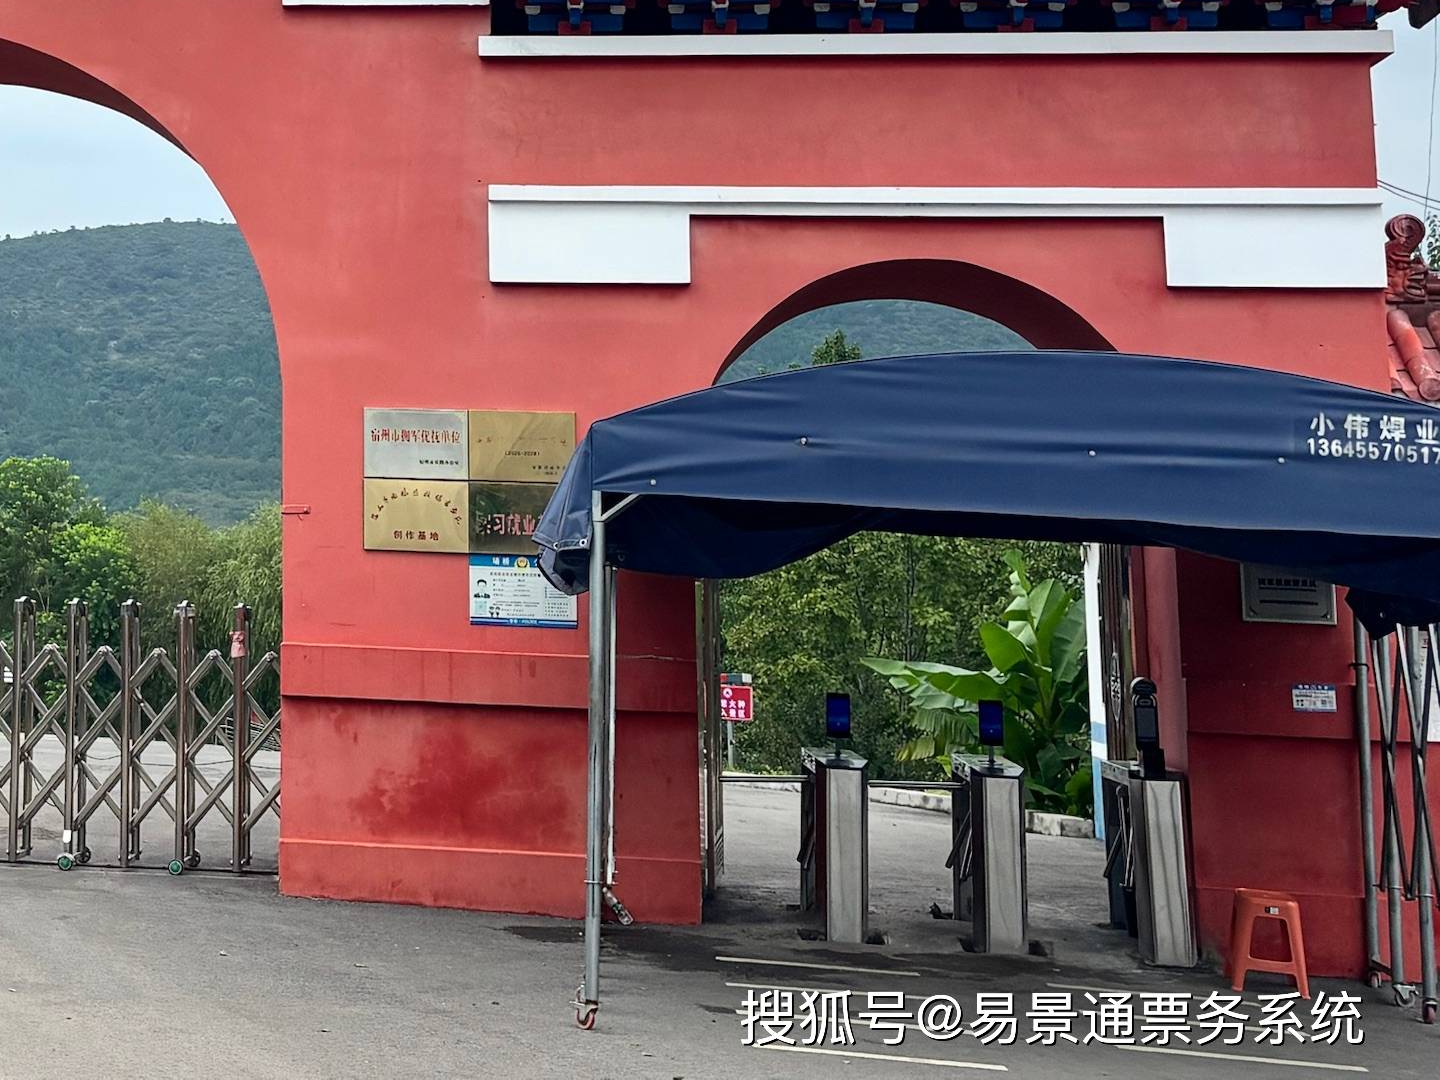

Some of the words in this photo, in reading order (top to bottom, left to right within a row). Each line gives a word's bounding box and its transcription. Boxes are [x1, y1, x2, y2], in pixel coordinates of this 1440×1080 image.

[1307, 437, 1440, 465] 13645570517
[475, 513, 543, 536] 实习就业
